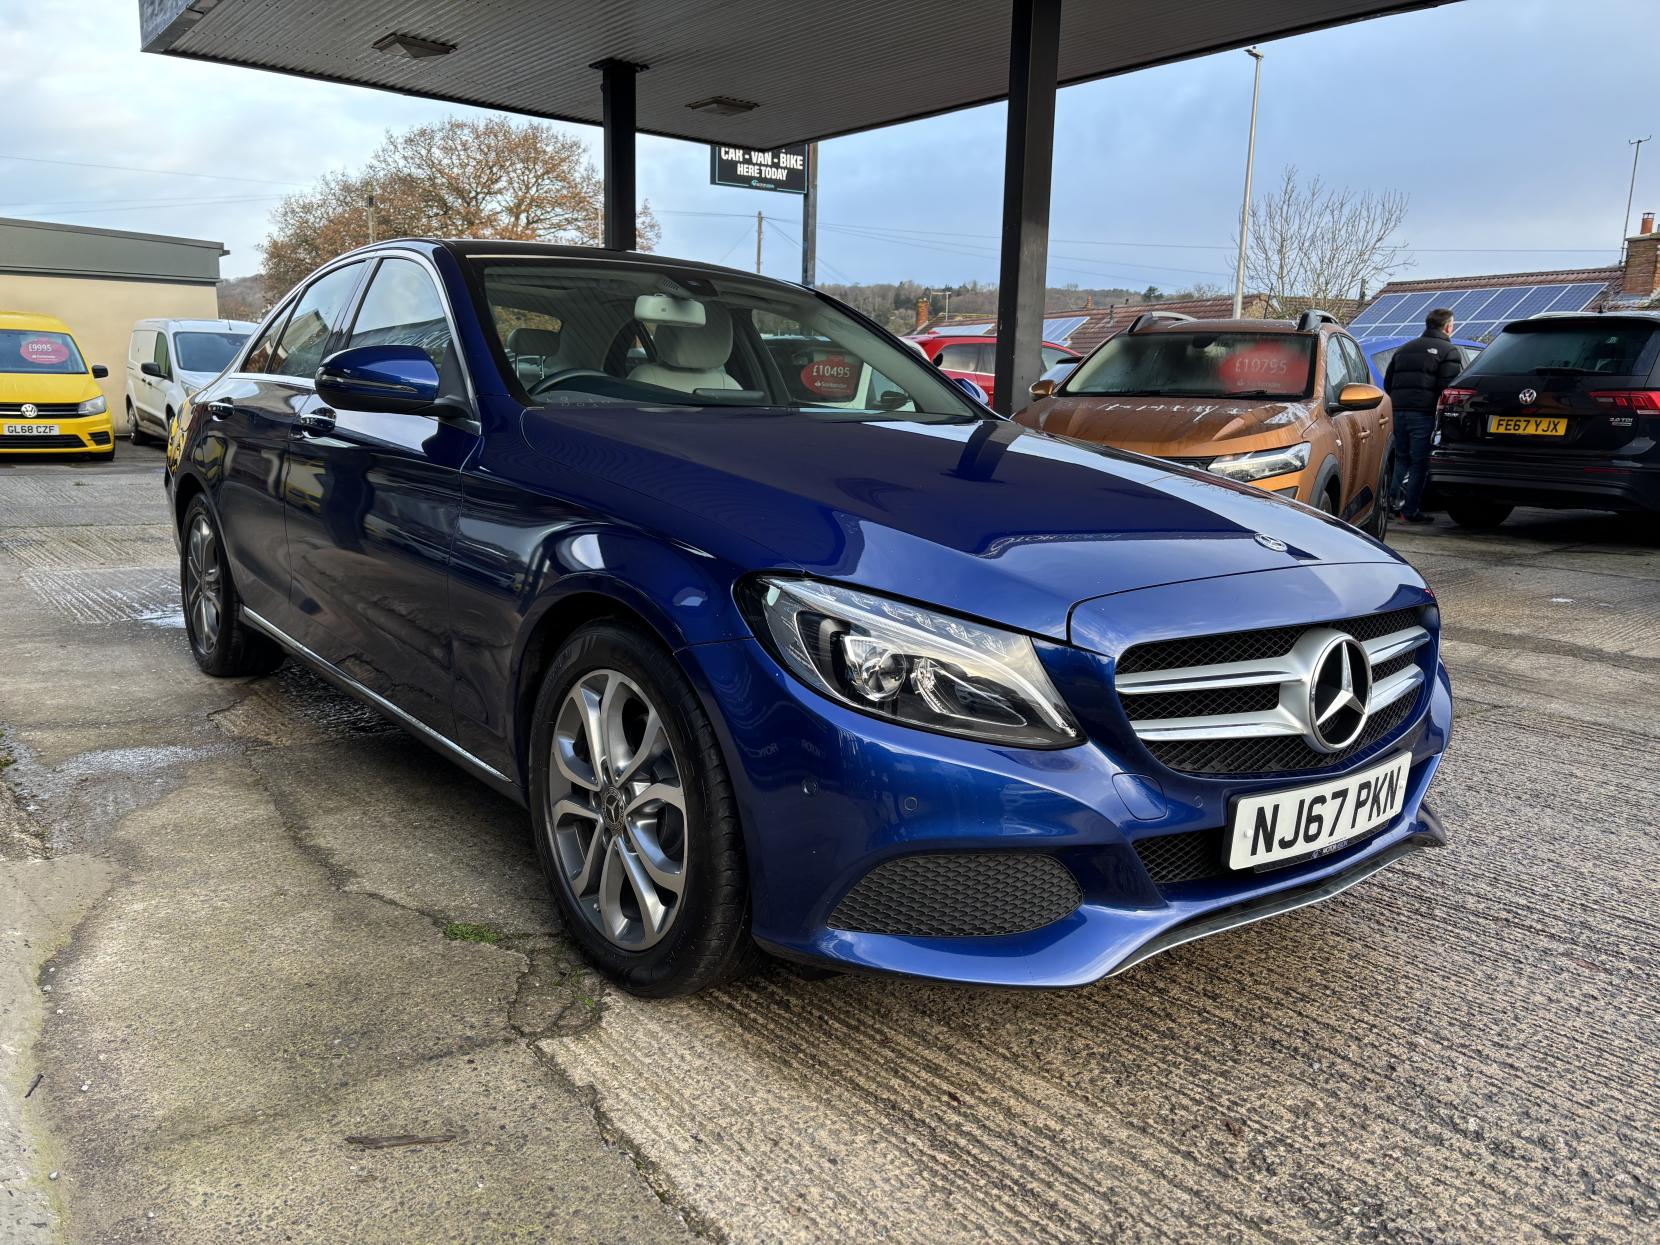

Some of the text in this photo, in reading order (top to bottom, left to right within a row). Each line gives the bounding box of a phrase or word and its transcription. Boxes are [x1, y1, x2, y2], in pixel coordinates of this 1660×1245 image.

[721, 147, 743, 161] CAR
[751, 151, 772, 165] VAN
[780, 153, 804, 169] BIKE
[737, 163, 788, 180] HERE TODAY
[812, 365, 850, 378] £10495
[1235, 358, 1288, 374] £10795
[7, 425, 55, 434] GL68 CZF
[1496, 418, 1561, 433] FE67 YJX
[1250, 765, 1402, 857] NJ67 PKN
